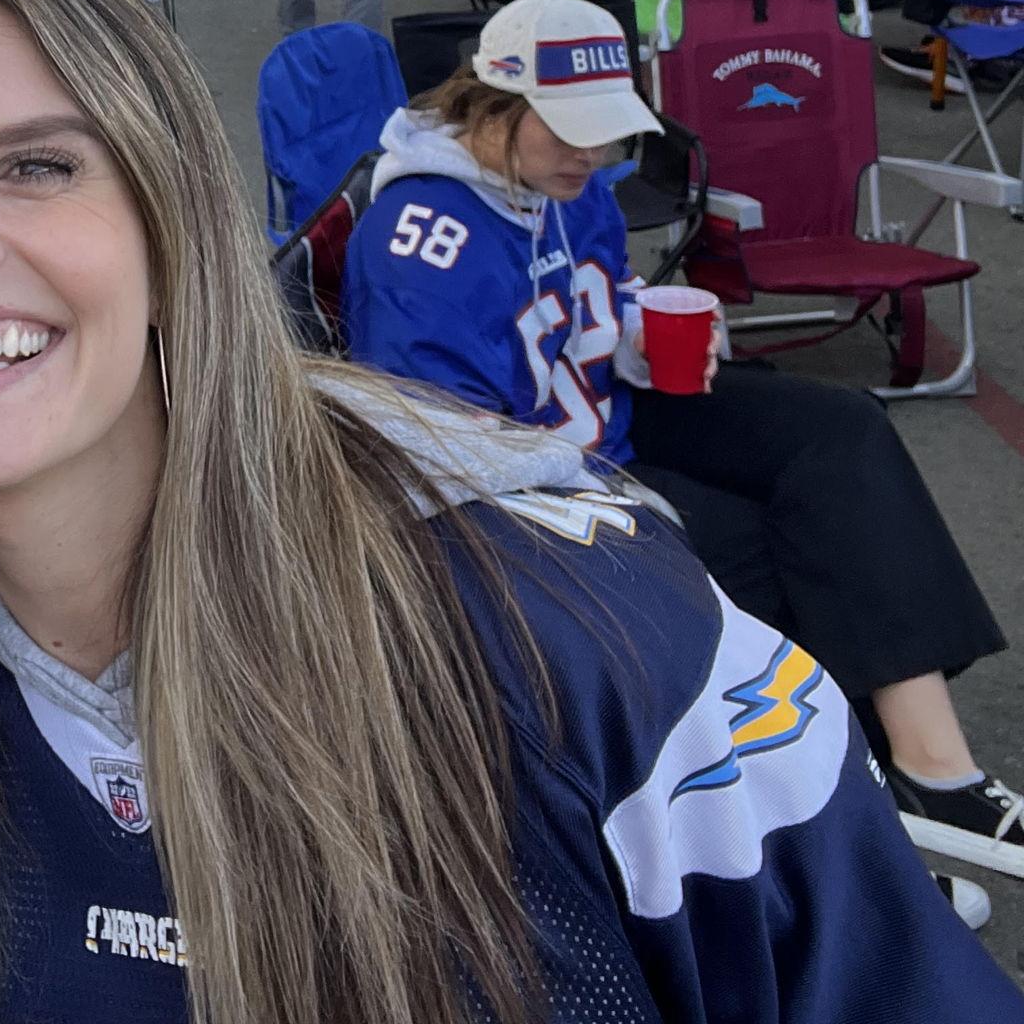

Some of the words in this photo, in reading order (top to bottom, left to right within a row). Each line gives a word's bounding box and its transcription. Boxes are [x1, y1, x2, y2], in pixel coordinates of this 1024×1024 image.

[571, 44, 628, 74] BILLS
[712, 50, 760, 81] TOMMY
[764, 48, 822, 78] BAHAMA
[389, 203, 470, 269] 58
